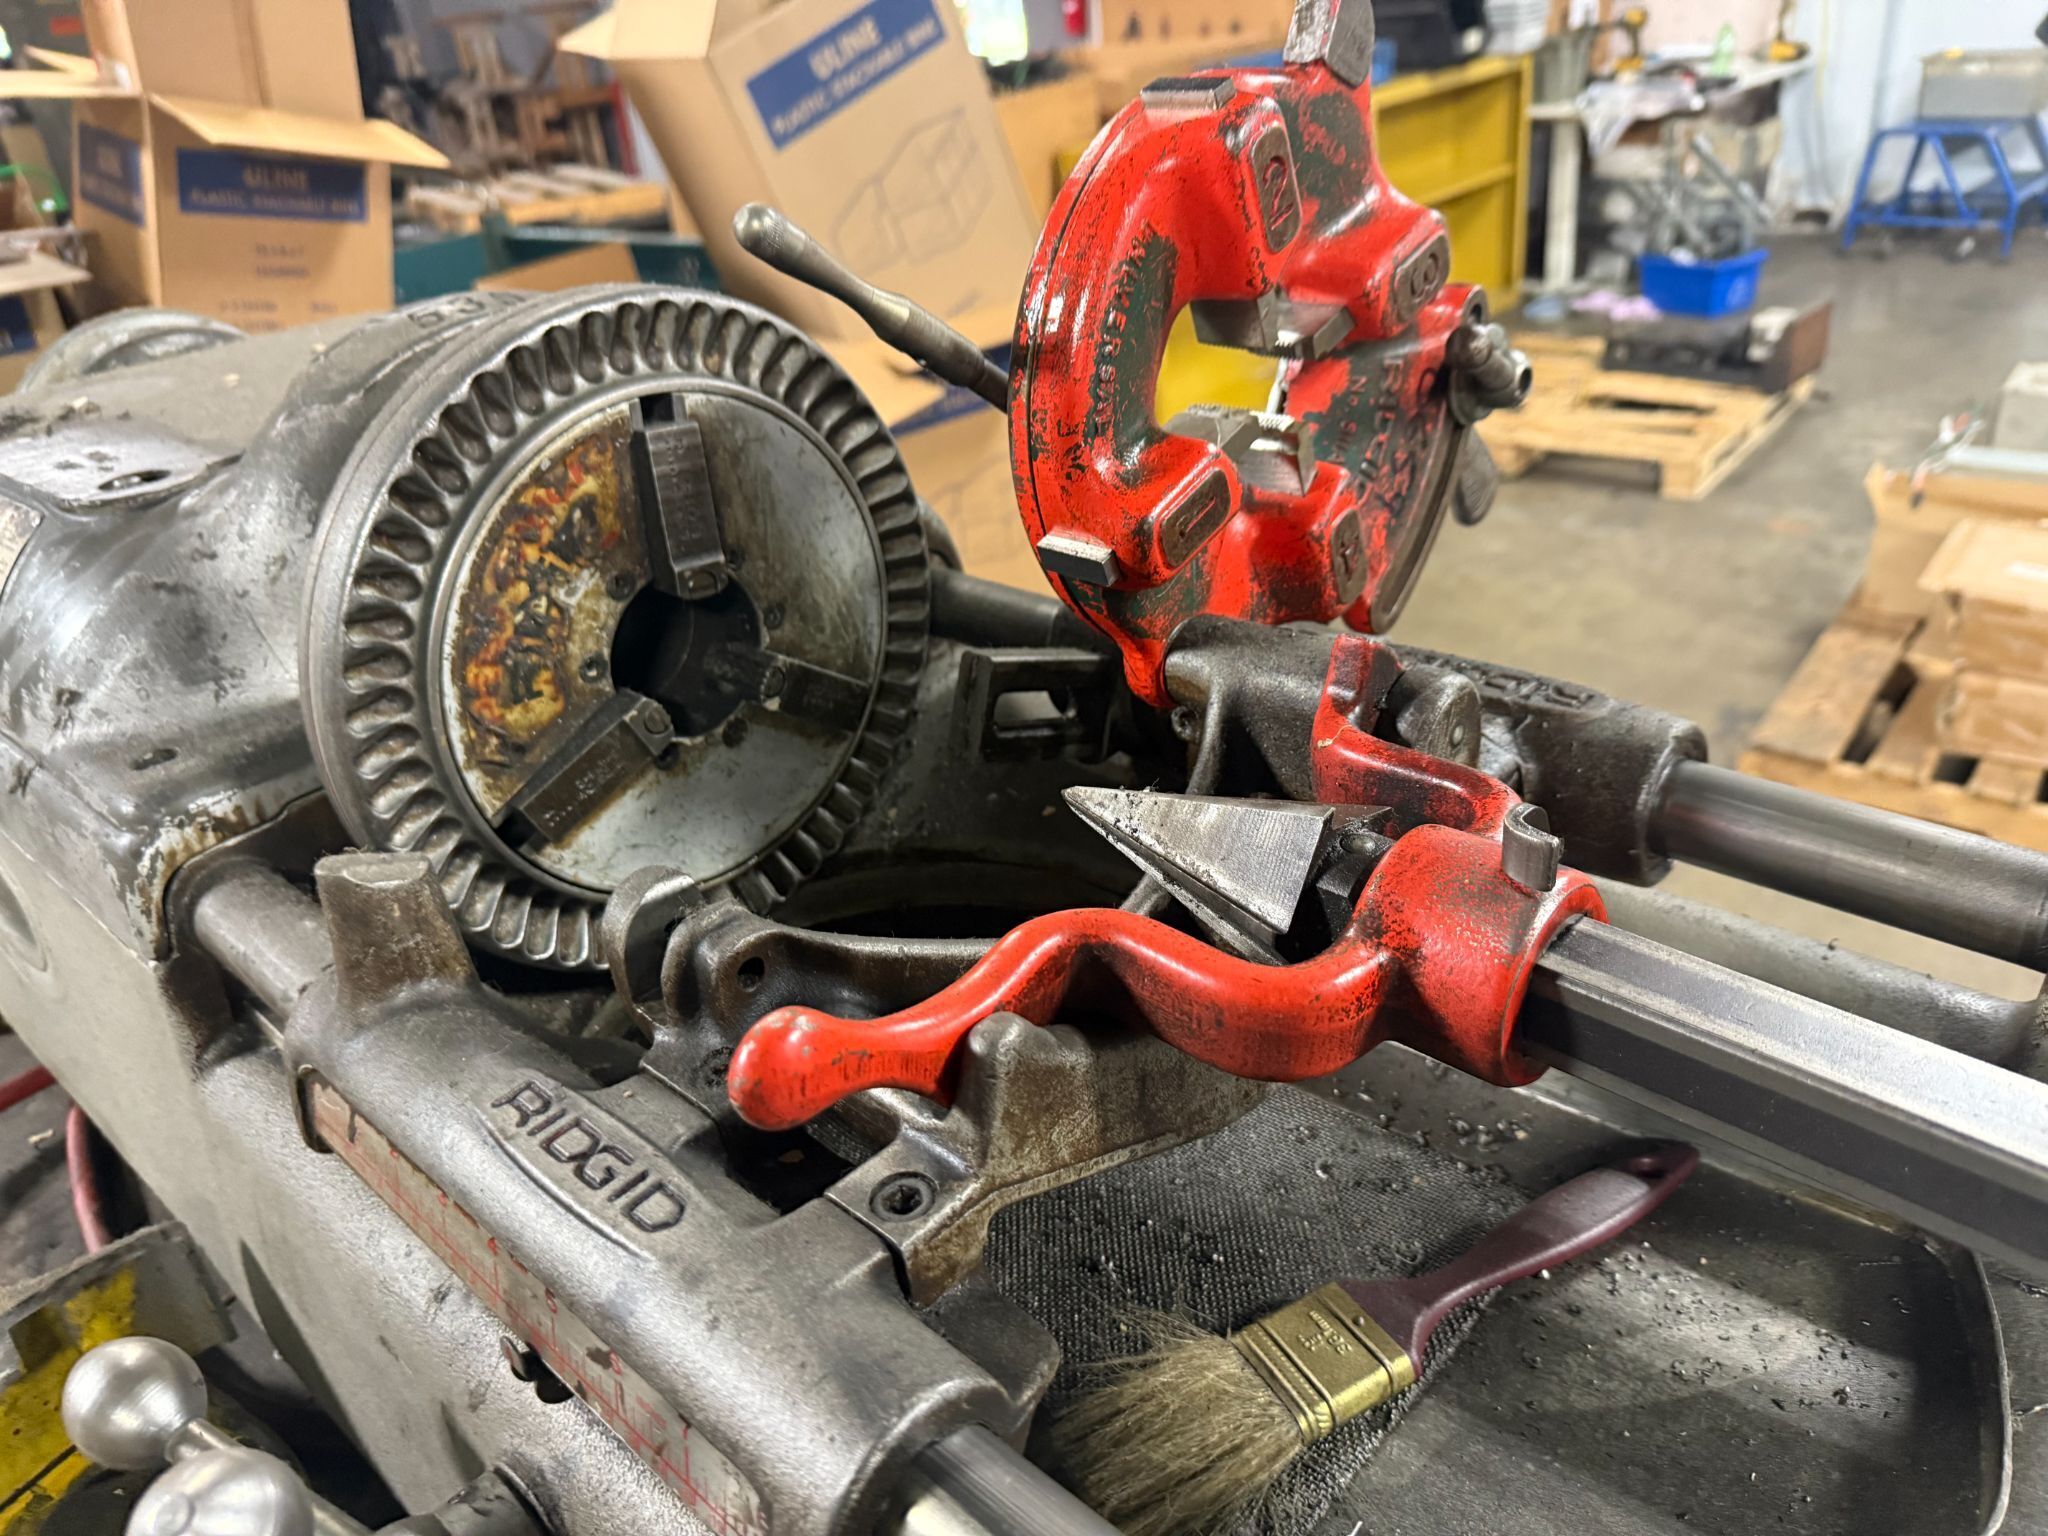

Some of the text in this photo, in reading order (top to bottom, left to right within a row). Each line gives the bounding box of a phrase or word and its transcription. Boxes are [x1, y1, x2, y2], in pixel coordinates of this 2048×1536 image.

[809, 16, 882, 81] ULINE
[242, 164, 308, 190] ULINE
[1262, 155, 1295, 231] 2
[1410, 252, 1439, 302] 3
[1176, 496, 1216, 538] 1
[490, 1080, 688, 1233] RIDGID
